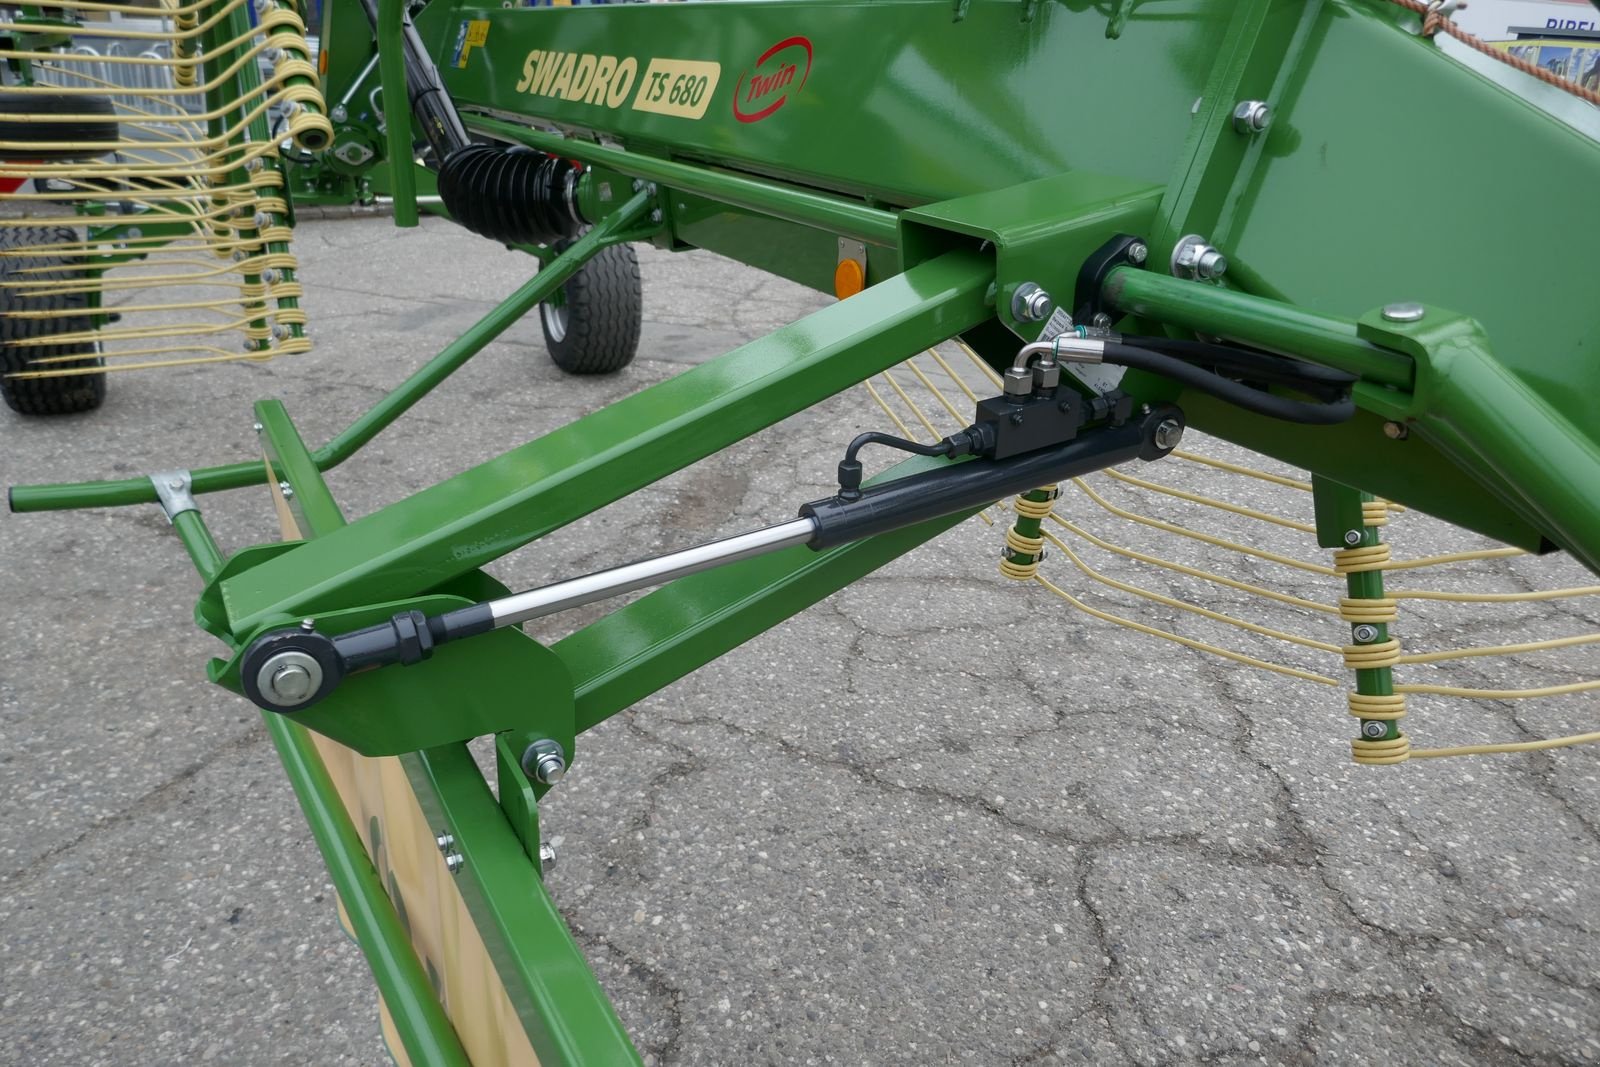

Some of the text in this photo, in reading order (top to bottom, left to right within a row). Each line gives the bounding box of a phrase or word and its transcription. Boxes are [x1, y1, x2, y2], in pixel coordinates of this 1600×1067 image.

[516, 49, 709, 109] SWADRO TS 680
[746, 63, 797, 103] Twin
